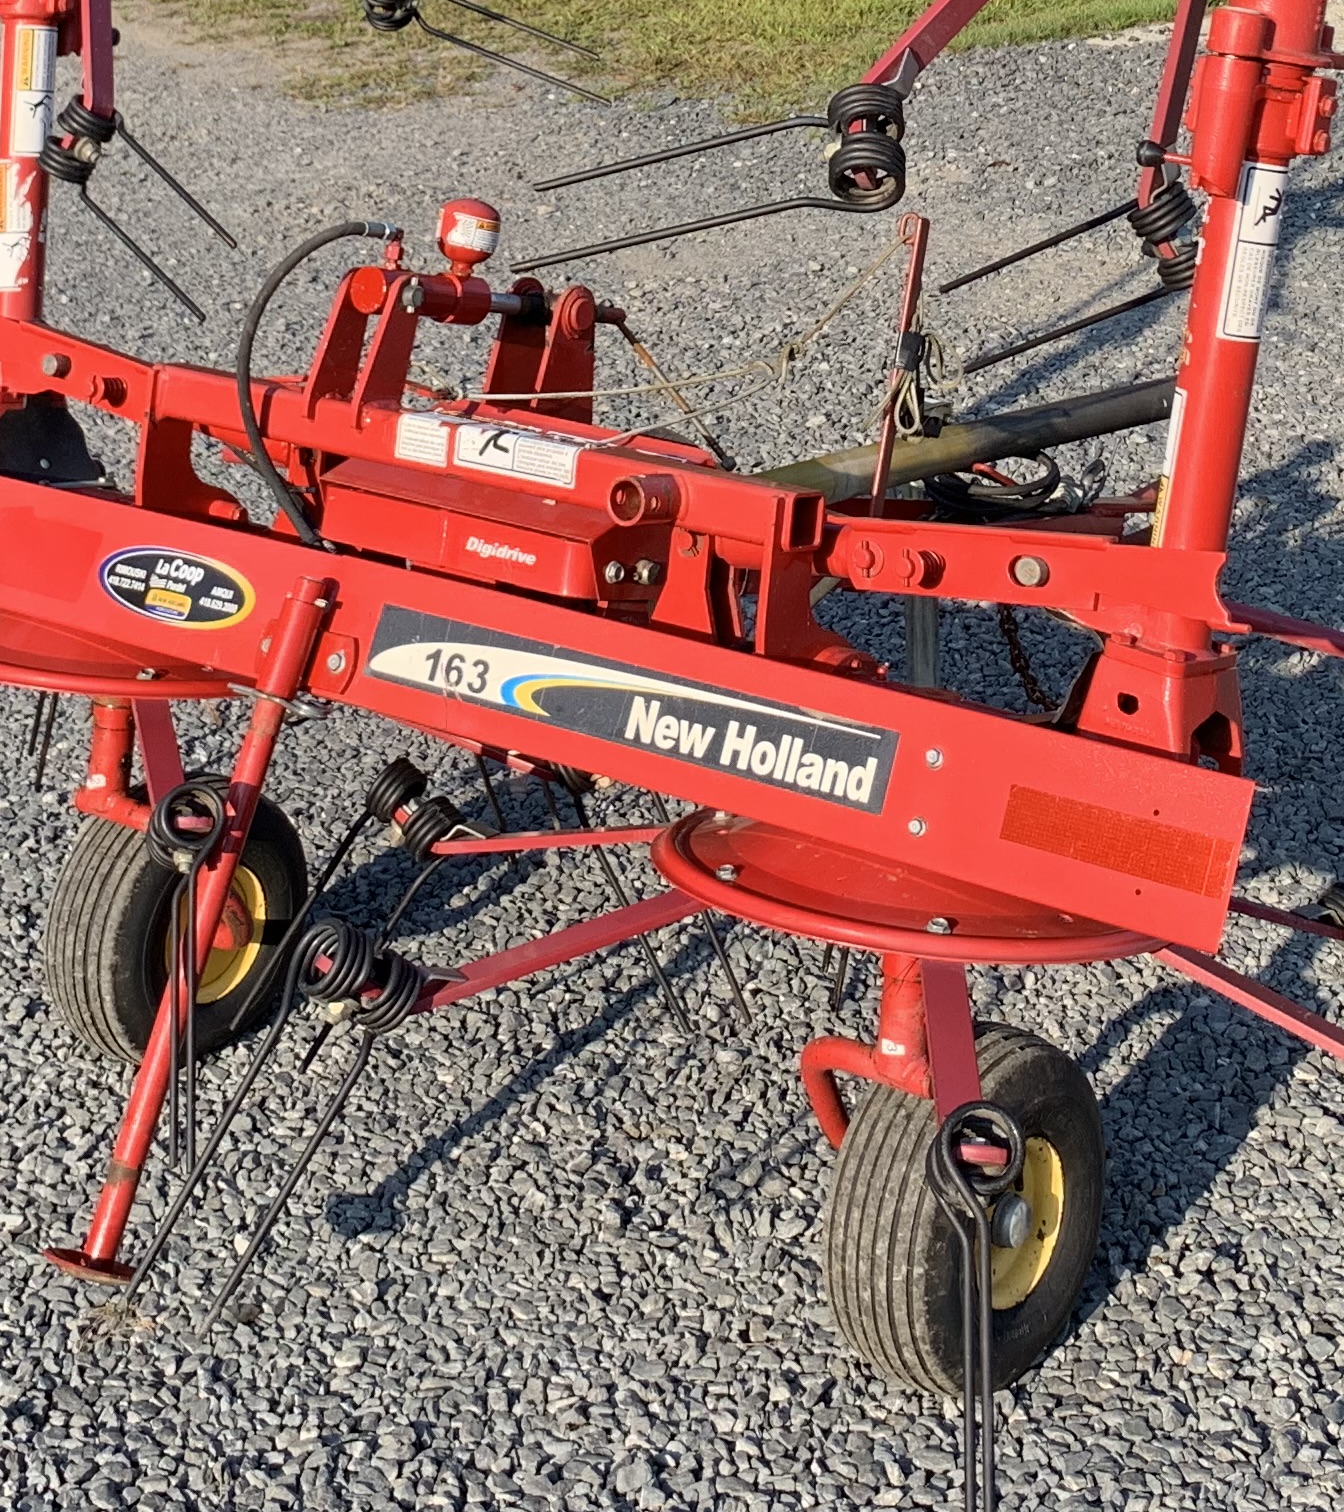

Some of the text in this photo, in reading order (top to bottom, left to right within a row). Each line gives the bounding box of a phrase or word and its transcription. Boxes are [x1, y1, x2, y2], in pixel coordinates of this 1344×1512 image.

[465, 536, 537, 566] Digidrive
[155, 559, 205, 586] La Coop
[424, 648, 491, 694] 163
[624, 696, 880, 805] New Holland
